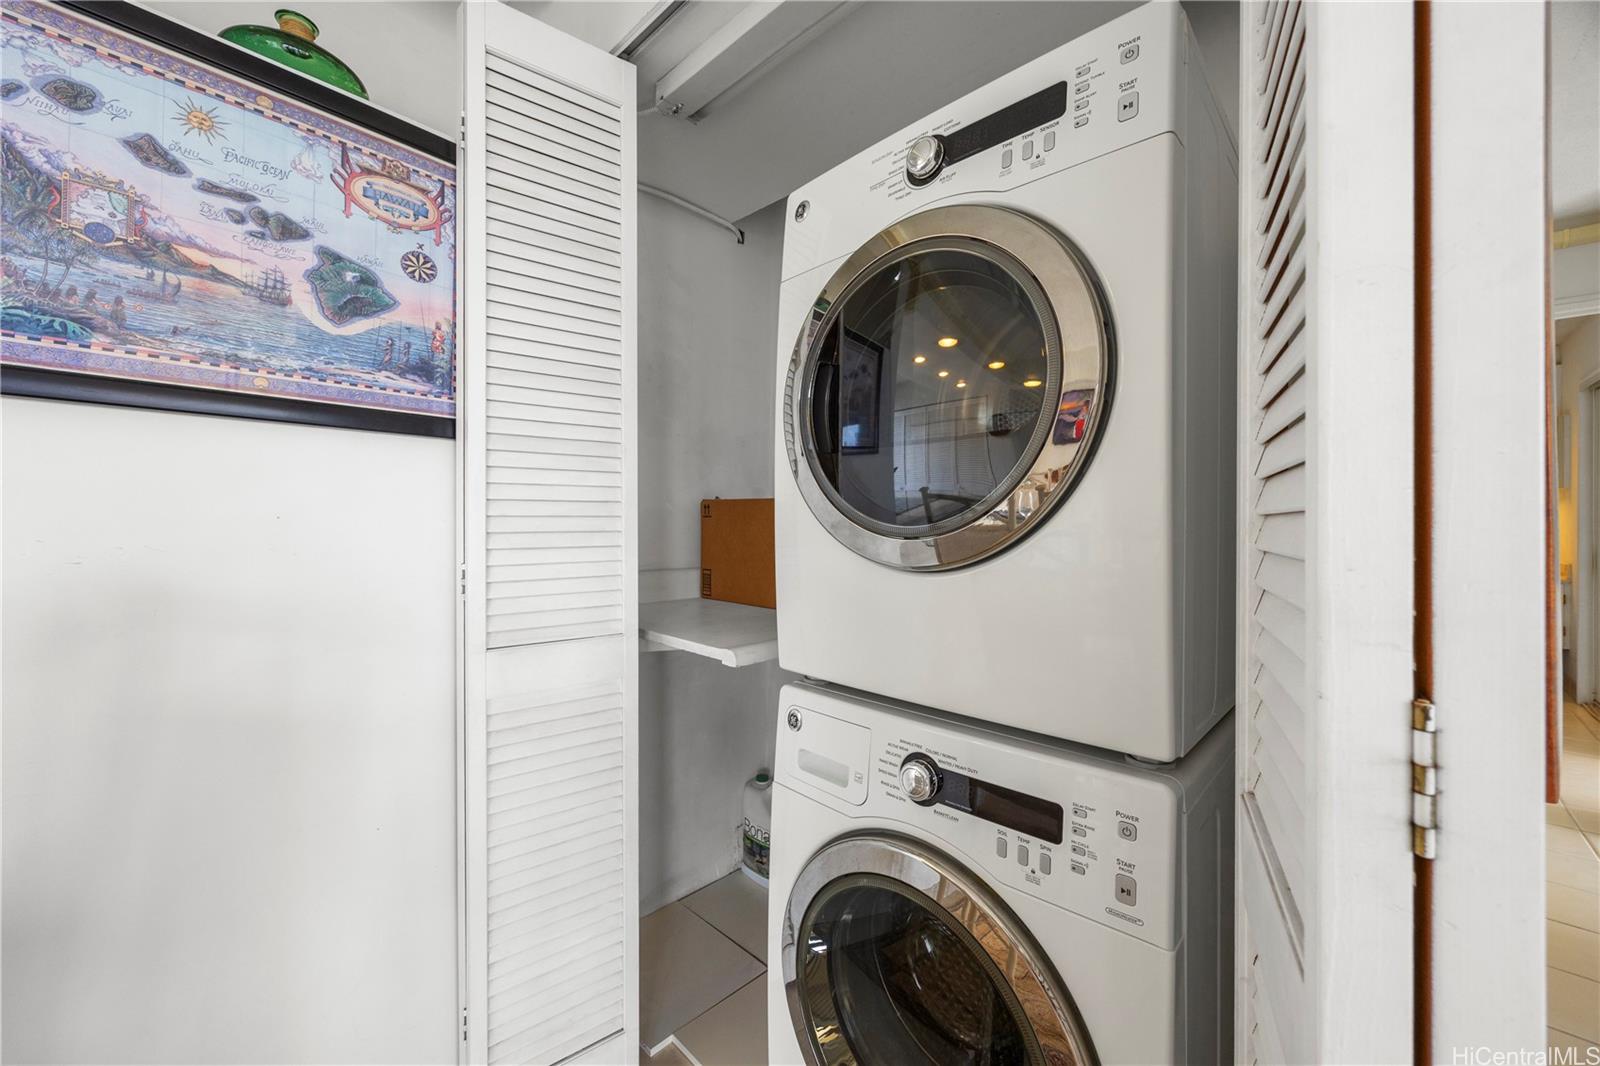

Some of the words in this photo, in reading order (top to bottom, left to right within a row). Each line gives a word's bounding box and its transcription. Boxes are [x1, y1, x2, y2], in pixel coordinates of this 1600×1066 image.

[1118, 36, 1140, 49] POWER
[1119, 77, 1138, 90] START
[222, 149, 261, 171] PACIFIC
[261, 160, 292, 181] OCEAN
[1115, 810, 1140, 822] POWER
[1018, 835, 1030, 845] TEMP
[1116, 858, 1136, 870] START
